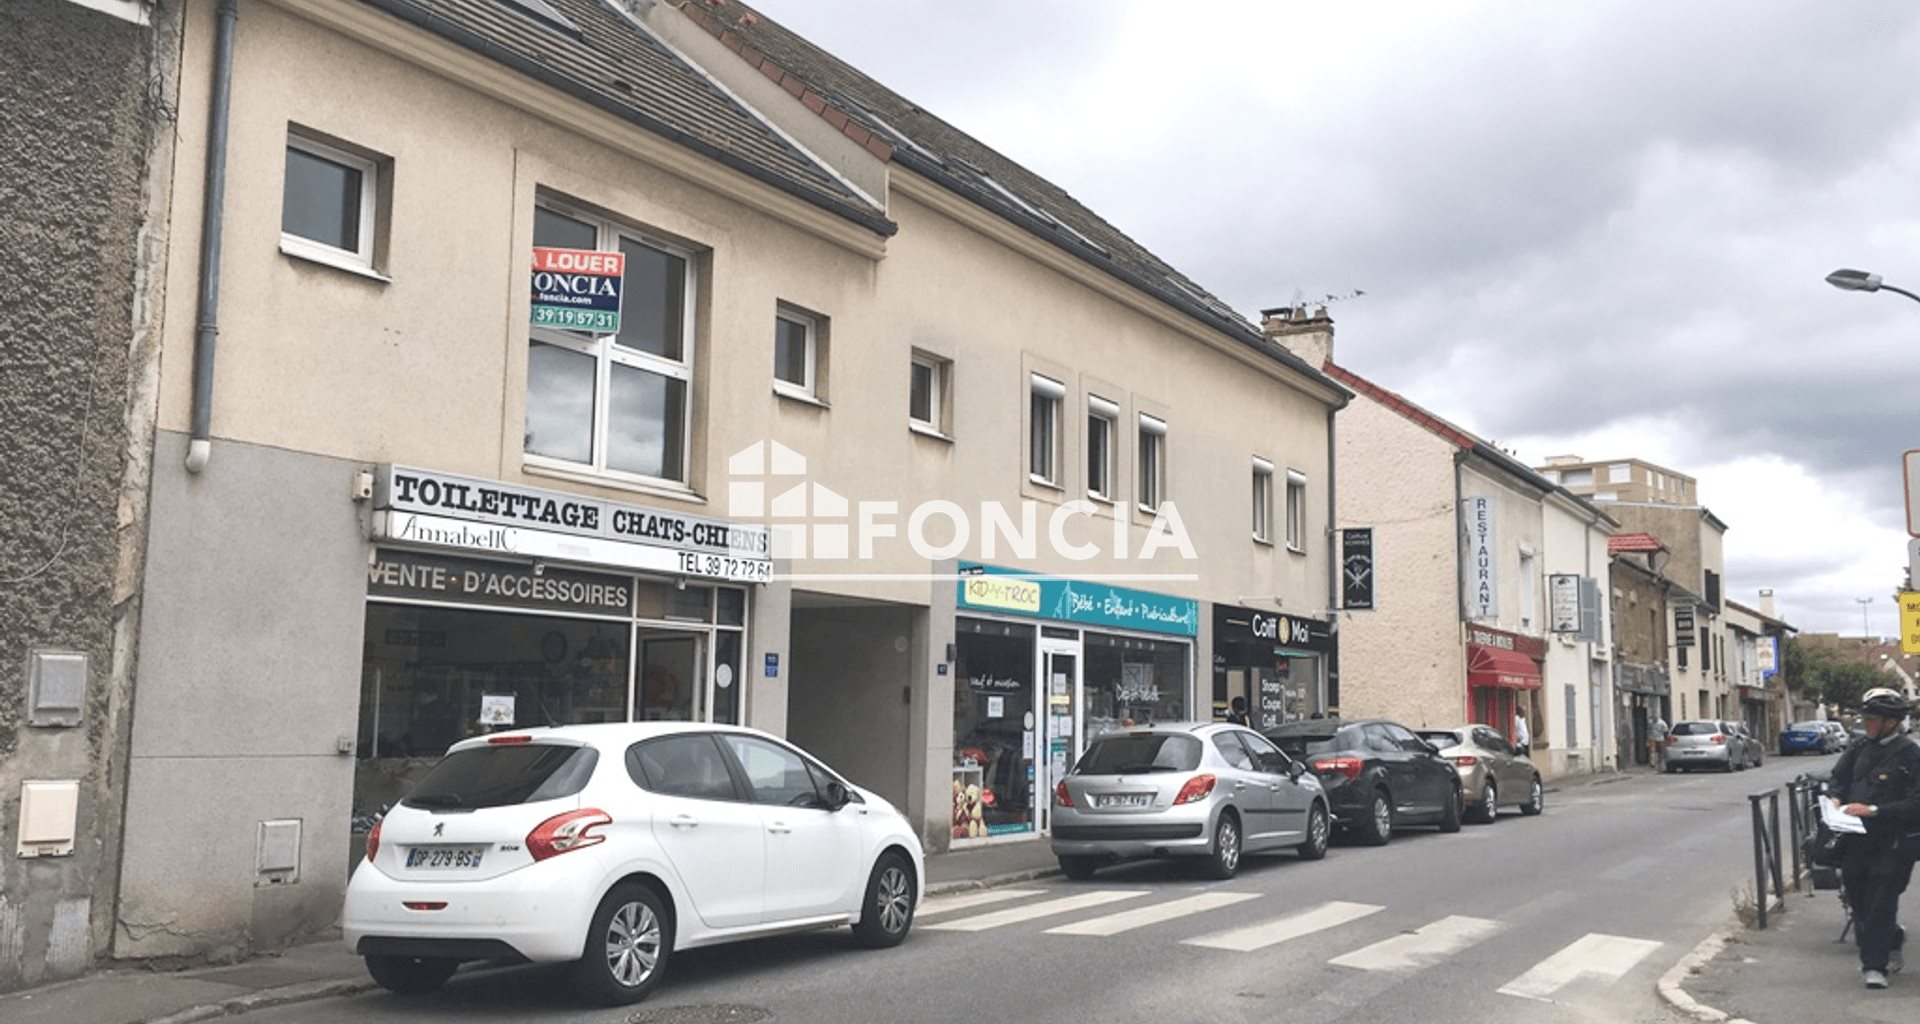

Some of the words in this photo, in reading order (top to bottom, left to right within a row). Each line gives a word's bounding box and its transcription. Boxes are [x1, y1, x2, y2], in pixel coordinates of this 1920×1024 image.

[546, 252, 618, 273] LOUER
[531, 272, 617, 296] ONCIA
[536, 308, 554, 322] 39
[558, 311, 573, 323] 19
[577, 313, 593, 325] 57
[597, 314, 613, 327] 31
[395, 474, 600, 530] TOILETTAGE
[613, 509, 768, 553] CHATS-CHIENS
[678, 552, 702, 574] TEL
[705, 556, 720, 576] 39
[724, 559, 739, 577] 72
[741, 560, 756, 578] 72
[758, 562, 771, 580] 64
[1477, 499, 1490, 616] RESTAURANT
[367, 562, 447, 591] VENTE
[464, 570, 629, 608] D'ACCESSOIRES
